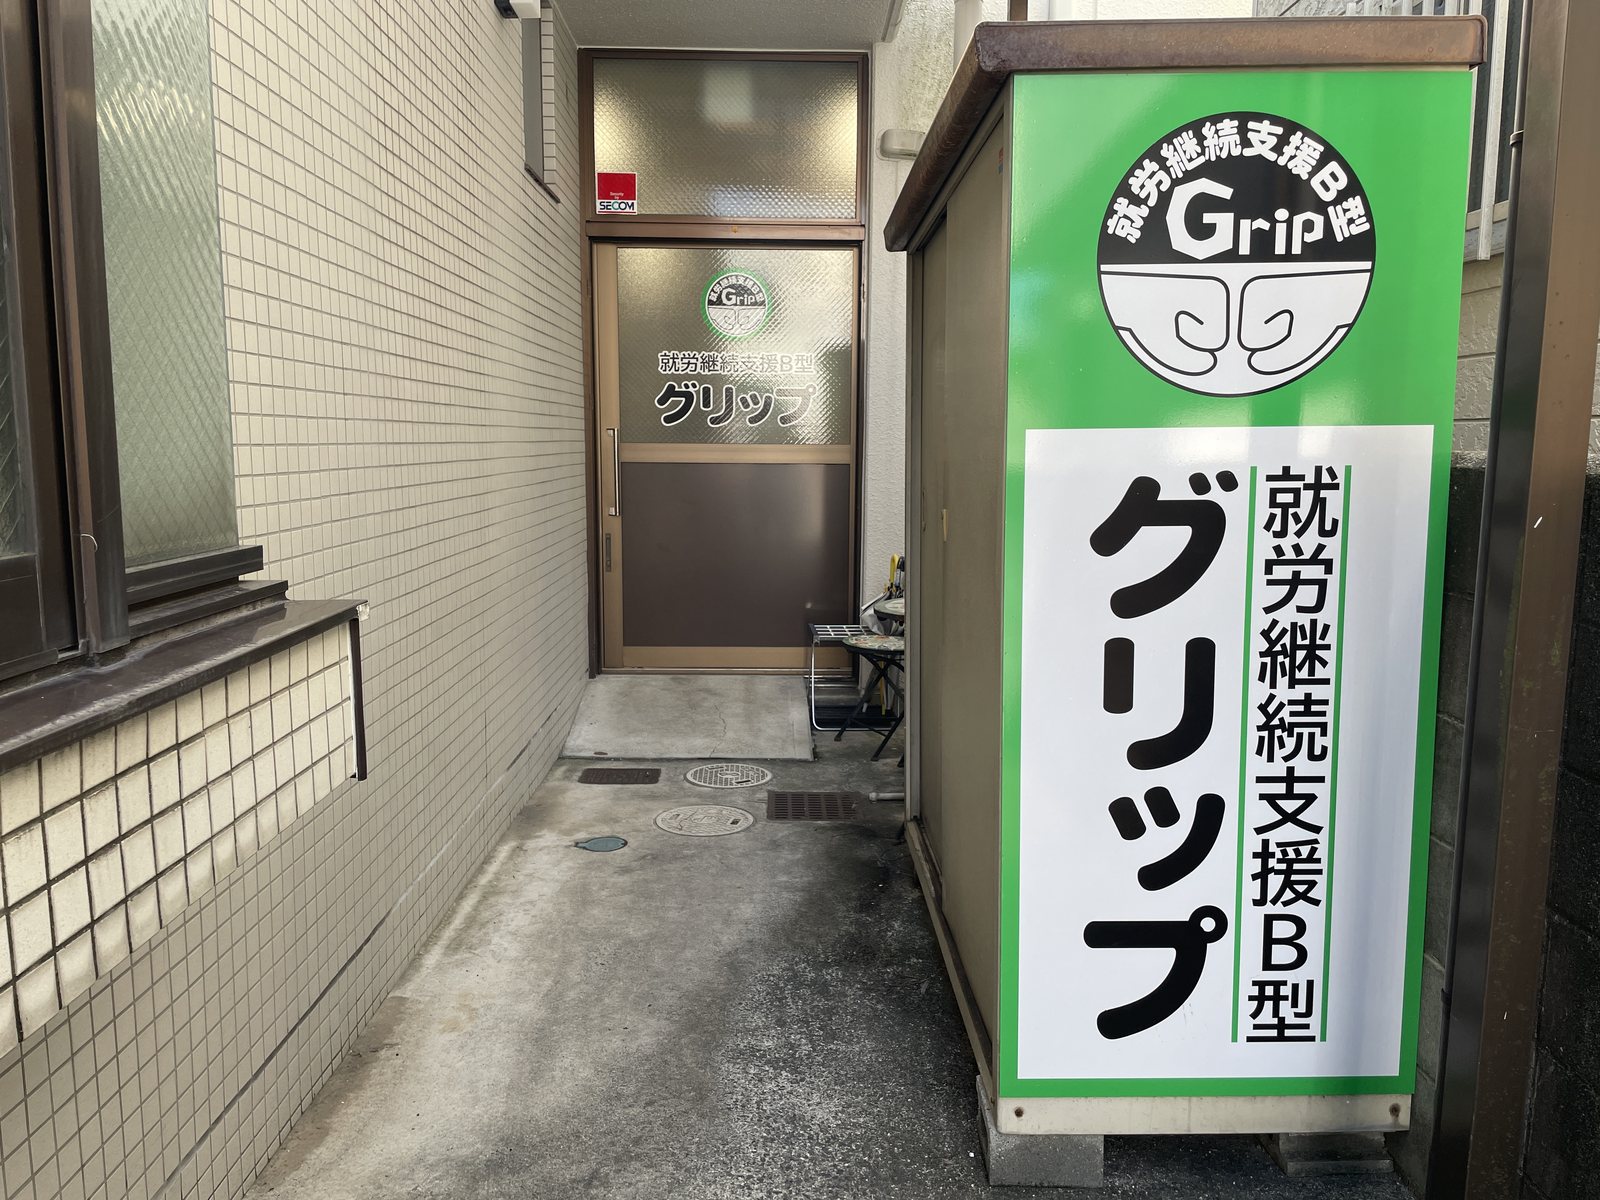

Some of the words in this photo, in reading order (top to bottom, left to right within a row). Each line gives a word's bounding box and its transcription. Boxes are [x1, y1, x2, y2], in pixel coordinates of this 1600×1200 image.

[599, 201, 635, 211] SECOM
[1106, 118, 1371, 243] 就労継続支援B型
[1165, 177, 1325, 260] Grip
[721, 287, 756, 305] Grip
[659, 352, 815, 374] 就労継続支援B型
[656, 381, 818, 428] グリップ
[1084, 470, 1238, 1039] グリップ
[1246, 465, 1339, 1043] 就労継続支援B型
